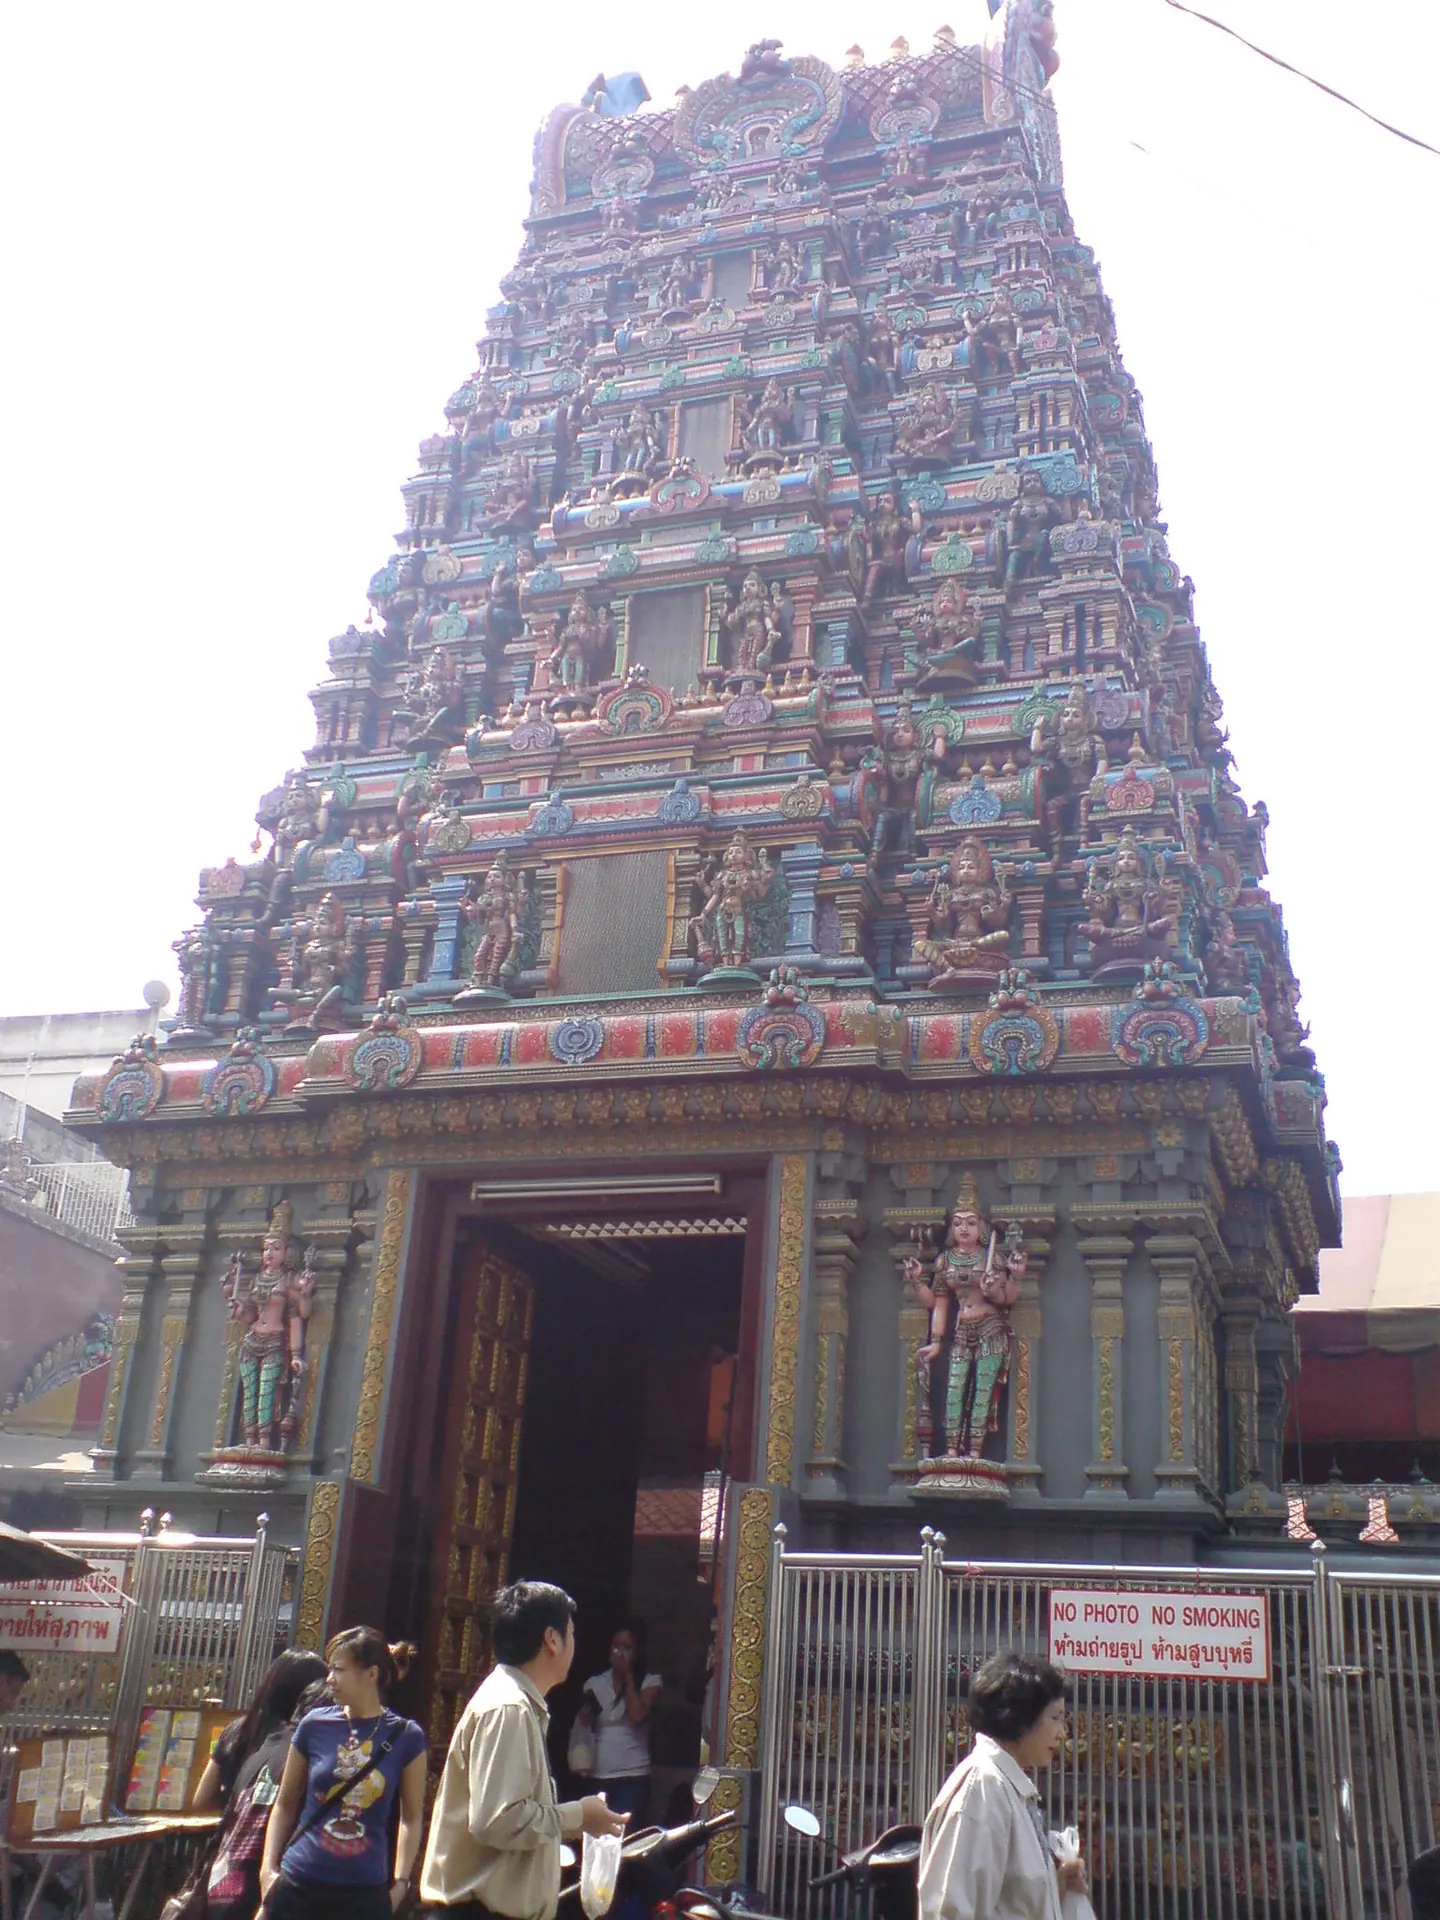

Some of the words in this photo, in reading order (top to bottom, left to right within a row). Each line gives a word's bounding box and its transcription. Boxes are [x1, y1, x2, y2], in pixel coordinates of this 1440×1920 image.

[0, 1608, 110, 1647] ายให้สุภาพ
[1053, 1602, 1077, 1622] NO
[1084, 1603, 1140, 1625] PHOTO
[1151, 1605, 1176, 1626] NO
[1182, 1606, 1261, 1629] SMOKING
[1053, 1632, 1143, 1666] ห้ามถ่ายรูป
[1151, 1635, 1254, 1671] ห้ามสูบบุหรี่
